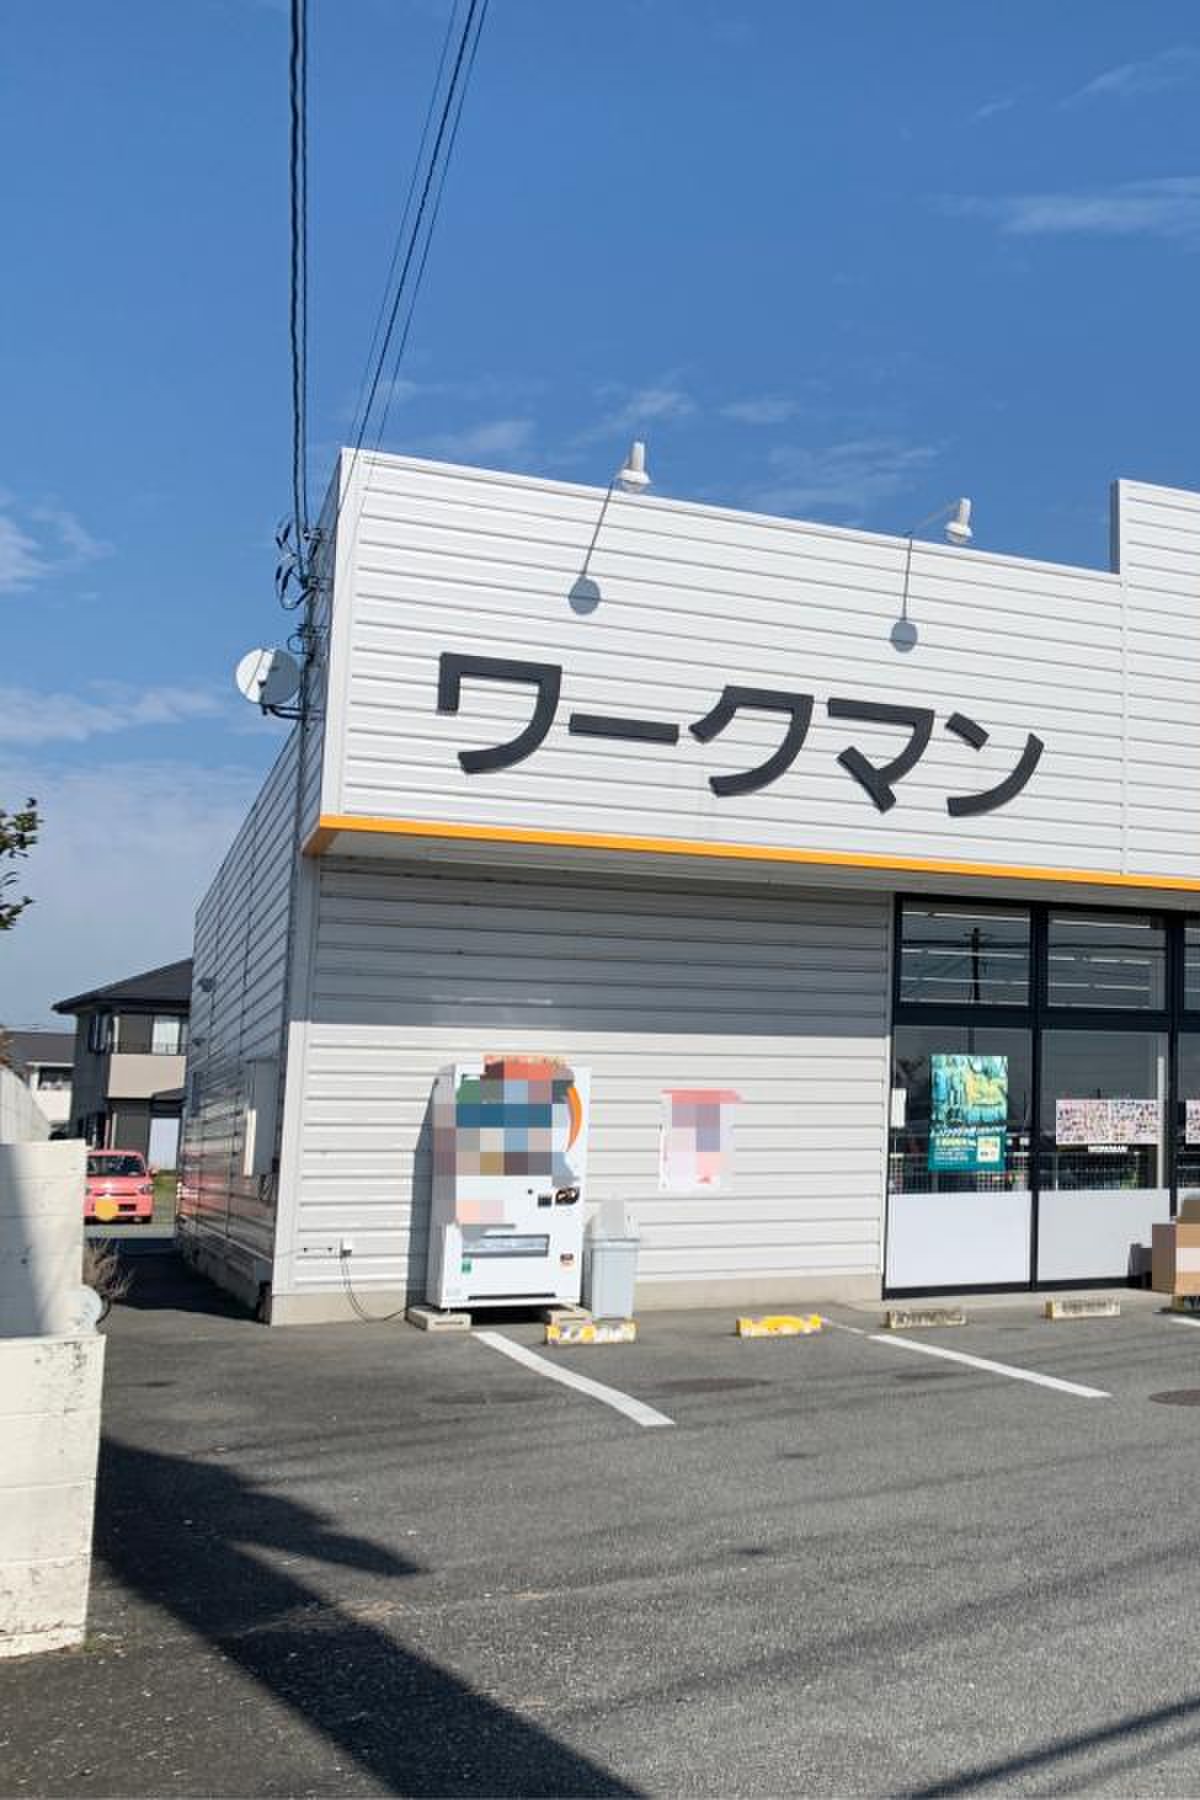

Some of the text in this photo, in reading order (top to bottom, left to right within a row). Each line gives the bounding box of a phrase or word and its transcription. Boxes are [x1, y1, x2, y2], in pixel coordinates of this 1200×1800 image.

[436, 652, 1044, 817] ワークマン
